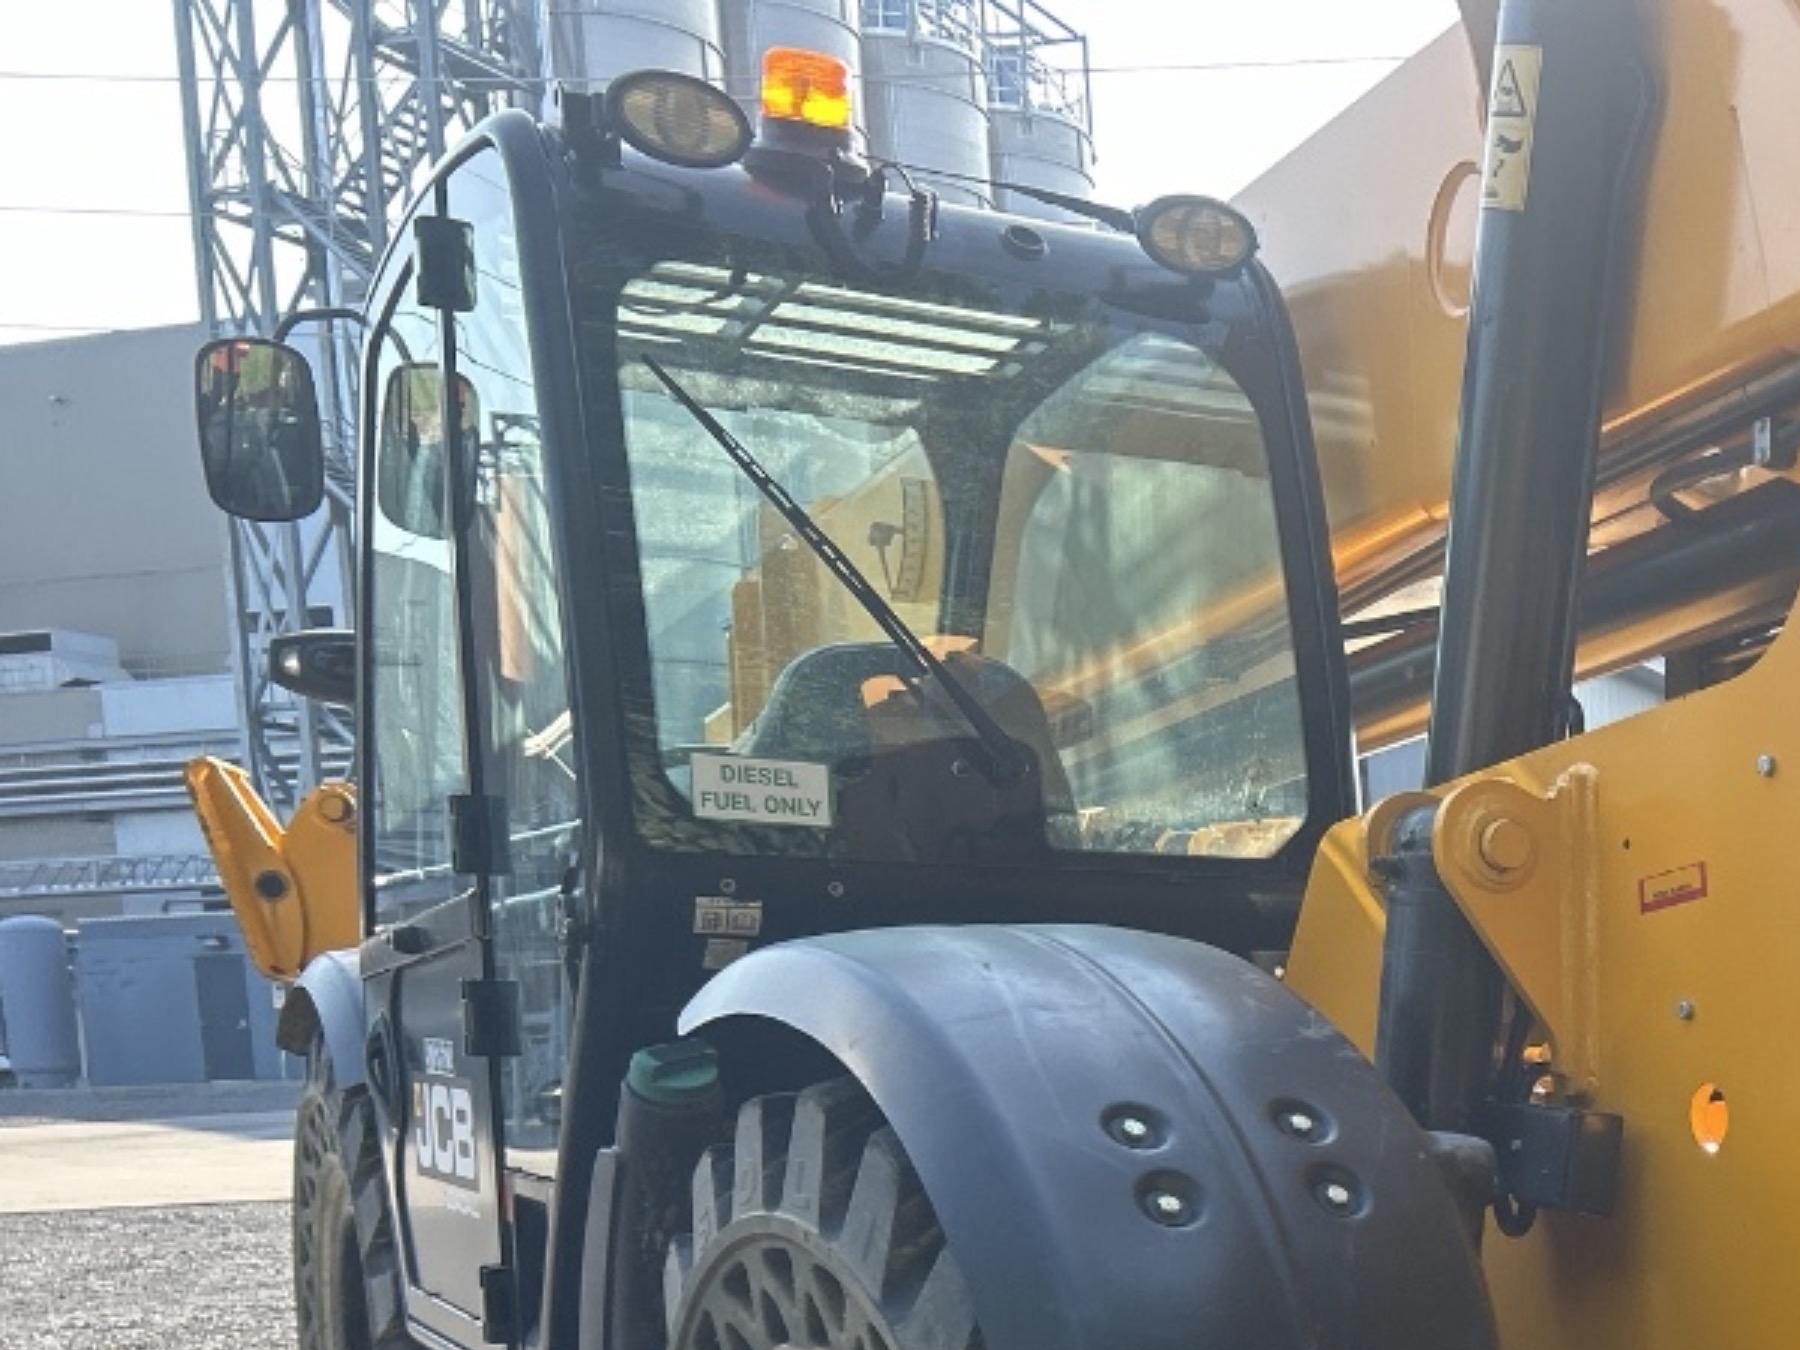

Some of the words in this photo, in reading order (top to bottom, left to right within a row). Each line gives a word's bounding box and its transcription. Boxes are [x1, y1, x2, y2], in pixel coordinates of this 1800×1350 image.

[720, 764, 798, 787] DIESEL
[700, 792, 756, 813] FUEL
[764, 795, 823, 817] ONLY
[415, 1081, 475, 1179] JCB
